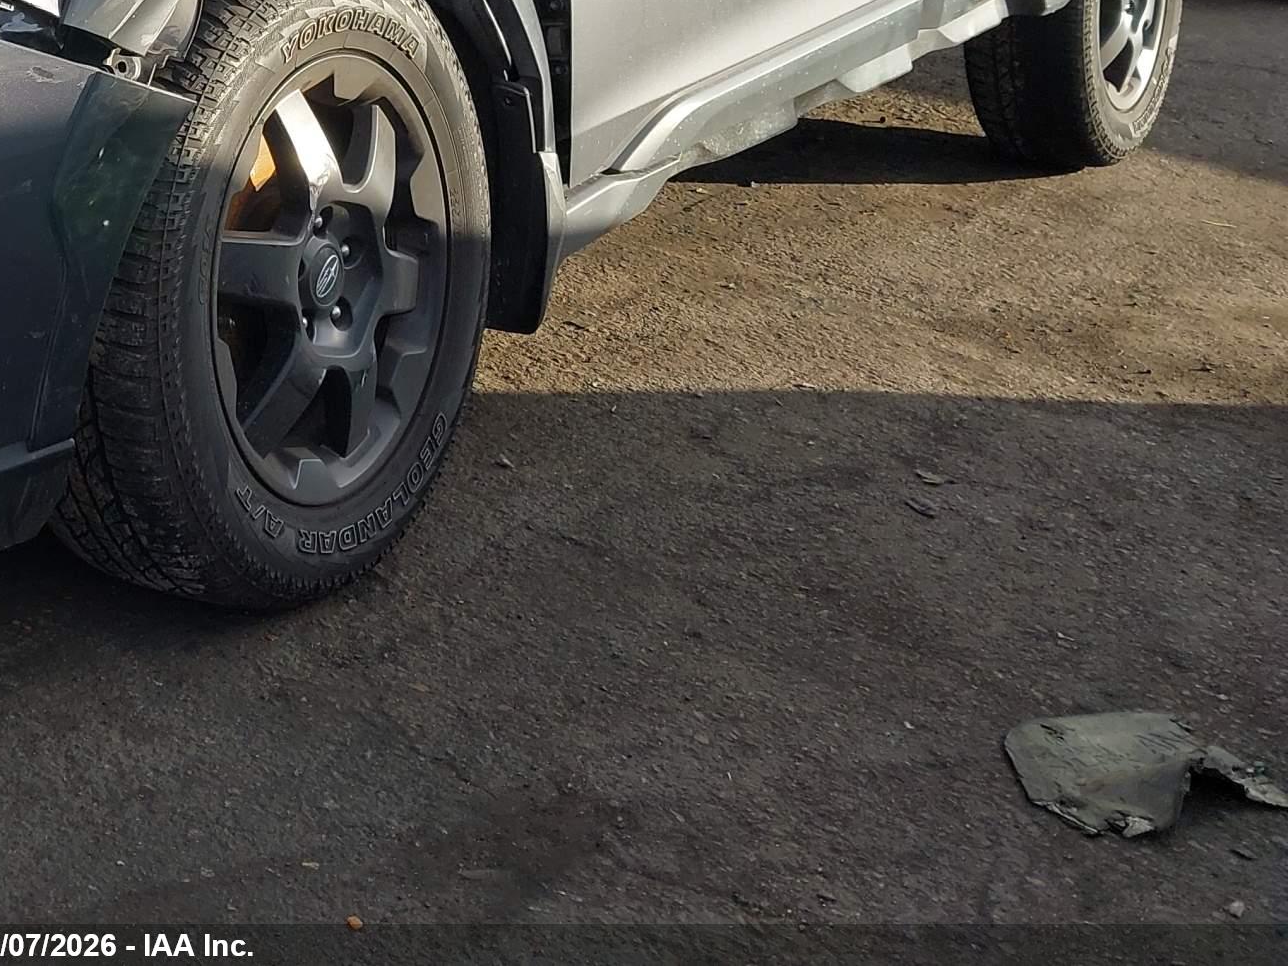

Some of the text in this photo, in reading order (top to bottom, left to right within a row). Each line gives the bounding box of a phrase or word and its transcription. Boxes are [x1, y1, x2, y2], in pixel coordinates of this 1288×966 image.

[280, 5, 420, 63] YOKOHAMA
[235, 412, 449, 555] GEOLANDAR A/T
